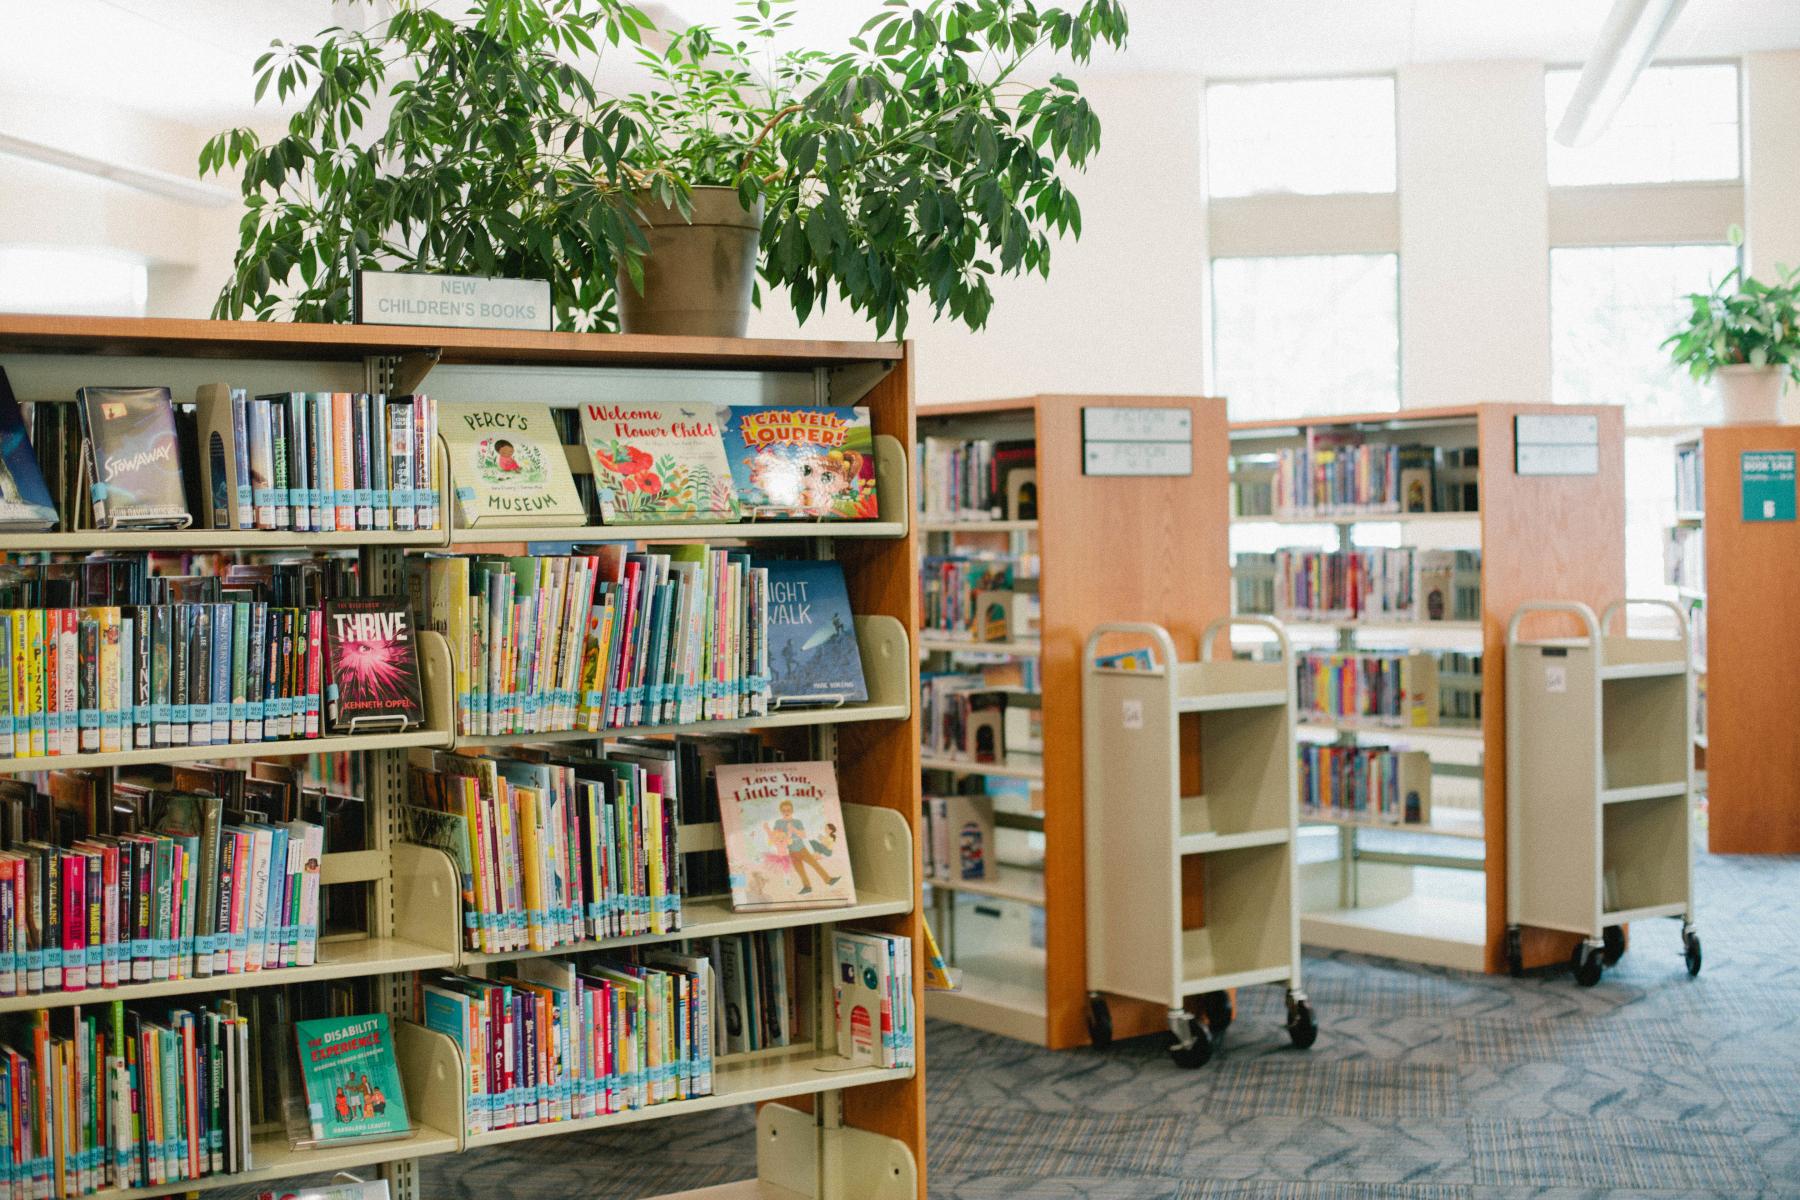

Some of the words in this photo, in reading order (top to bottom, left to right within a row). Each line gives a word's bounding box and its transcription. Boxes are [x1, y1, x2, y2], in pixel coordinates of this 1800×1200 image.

[441, 280, 476, 295] NEW
[378, 298, 475, 317] CHILDREN'S
[480, 303, 536, 319] BOOKS
[463, 411, 528, 430] PERCY'S
[588, 405, 662, 421] Welcome
[755, 413, 792, 425] CAN
[798, 413, 840, 428] YELL
[614, 423, 669, 438] Flower
[671, 422, 718, 438] Child
[743, 428, 844, 445] LOUDER!
[489, 494, 558, 511] MUSEUM
[768, 603, 813, 625] WALK
[333, 612, 408, 643] THRIVE
[742, 774, 778, 786] Love
[783, 772, 811, 784] You,
[734, 785, 779, 802] Little
[780, 785, 825, 800] Lady
[49, 854, 57, 878] TIME
[49, 881, 57, 925] VILLAINS
[324, 1019, 379, 1044] DISABILITY
[311, 1032, 381, 1062] EXPERIENCE
